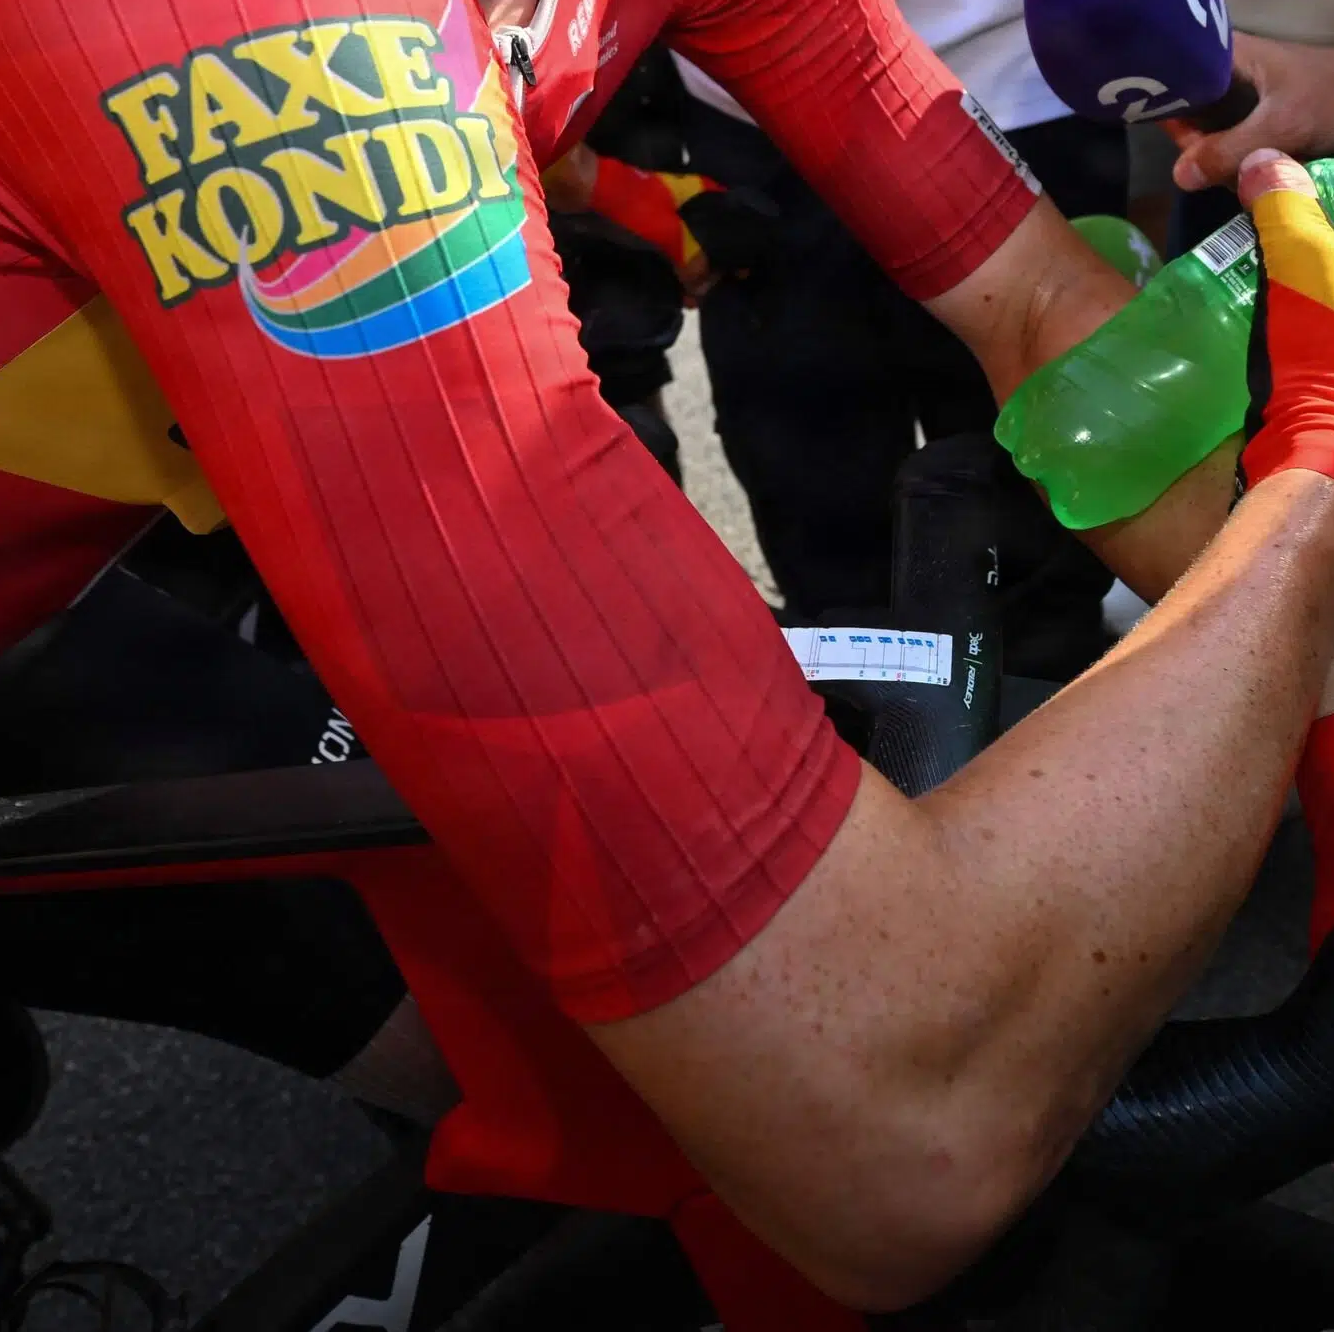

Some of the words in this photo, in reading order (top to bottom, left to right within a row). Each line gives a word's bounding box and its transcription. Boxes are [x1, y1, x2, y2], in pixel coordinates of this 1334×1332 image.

[107, 19, 450, 186] FAXE
[127, 118, 510, 302] KONDI
[963, 664, 977, 710] RIDLEY
